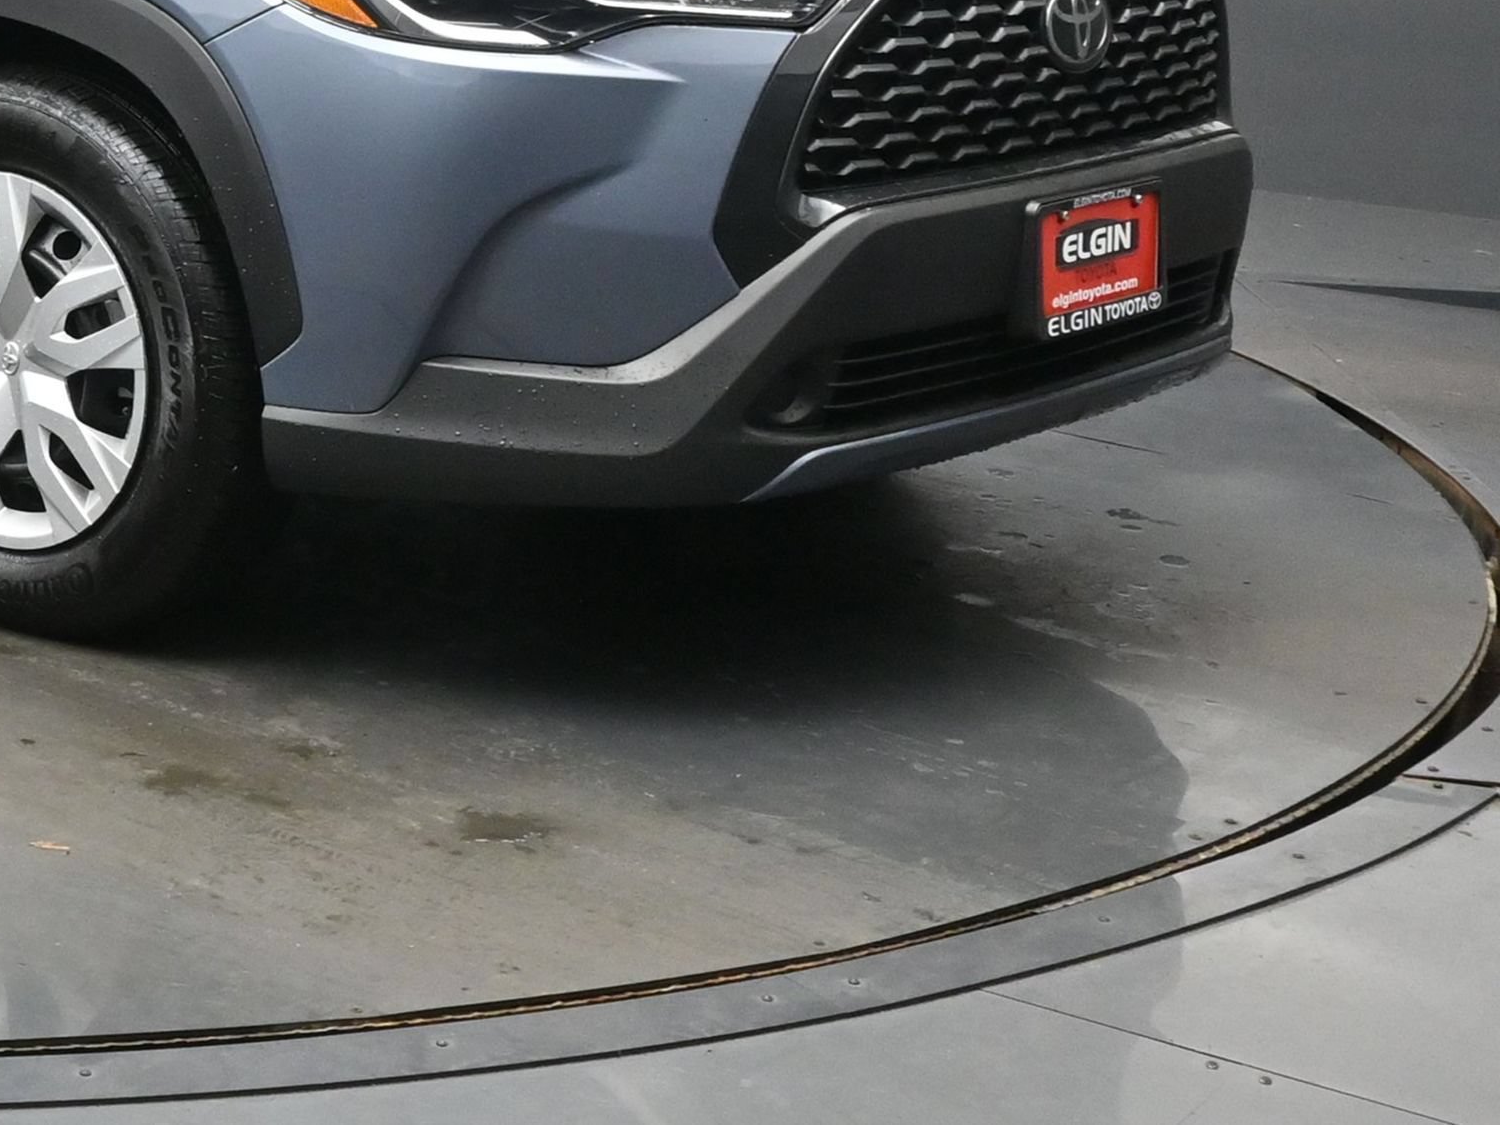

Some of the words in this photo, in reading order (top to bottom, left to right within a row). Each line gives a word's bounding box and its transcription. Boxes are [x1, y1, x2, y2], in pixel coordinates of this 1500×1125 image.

[1062, 221, 1132, 264] ELGIN
[1051, 277, 1139, 308] elgintoyota.com
[1047, 307, 1103, 337] ELGIN
[1104, 295, 1149, 321] TOYOTA
